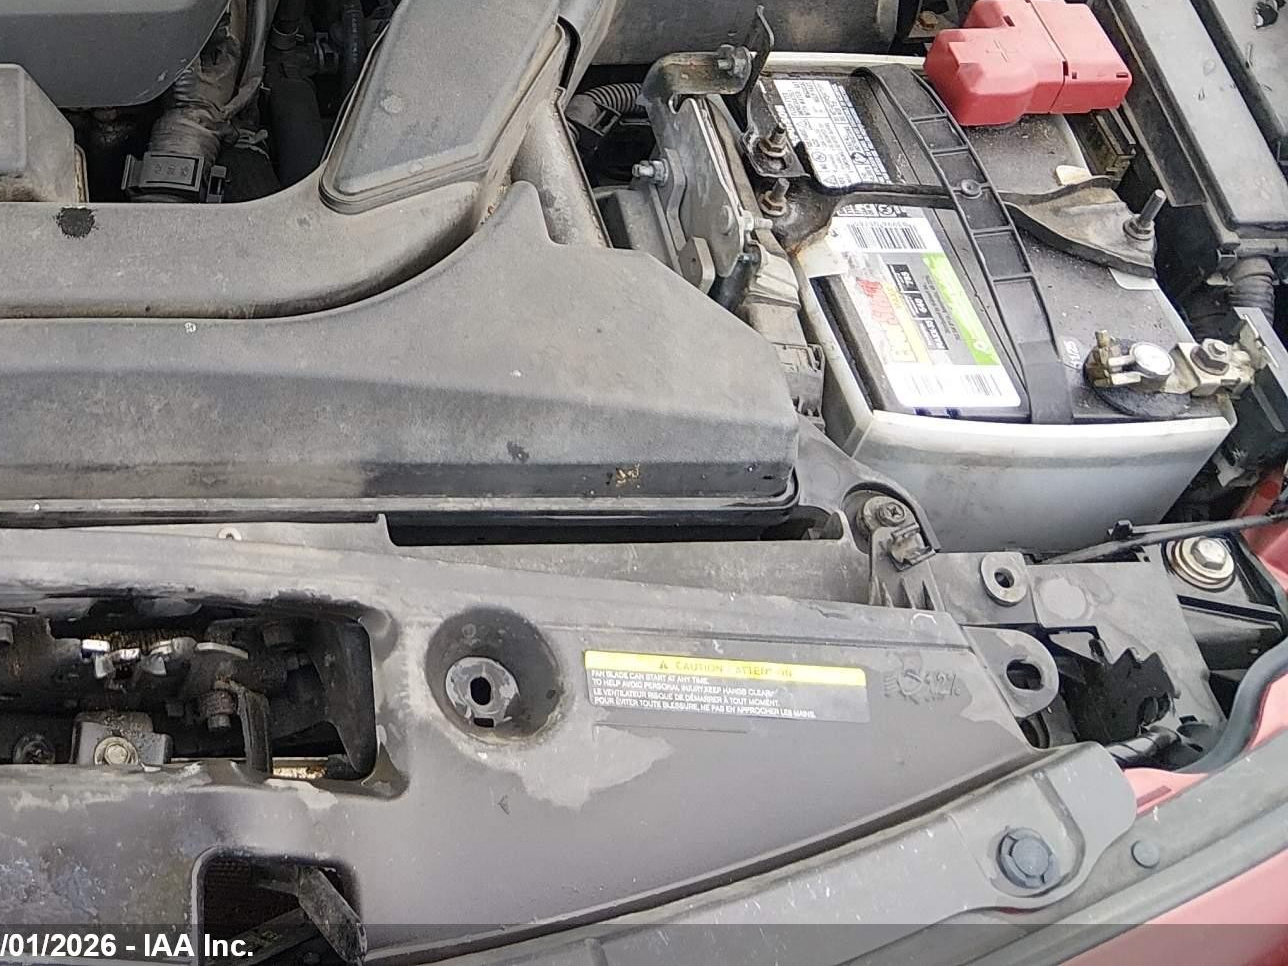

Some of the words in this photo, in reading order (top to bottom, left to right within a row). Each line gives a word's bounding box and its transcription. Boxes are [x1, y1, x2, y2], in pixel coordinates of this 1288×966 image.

[674, 661, 724, 675] CAUTION
[629, 672, 645, 680] CAN
[677, 675, 692, 683] ANY
[592, 678, 602, 686] TO
[603, 678, 621, 687] HELP
[622, 680, 643, 689] AVOID
[594, 696, 615, 705] POUR
[639, 699, 662, 708] TOUTE
[729, 696, 747, 705] TOUT
